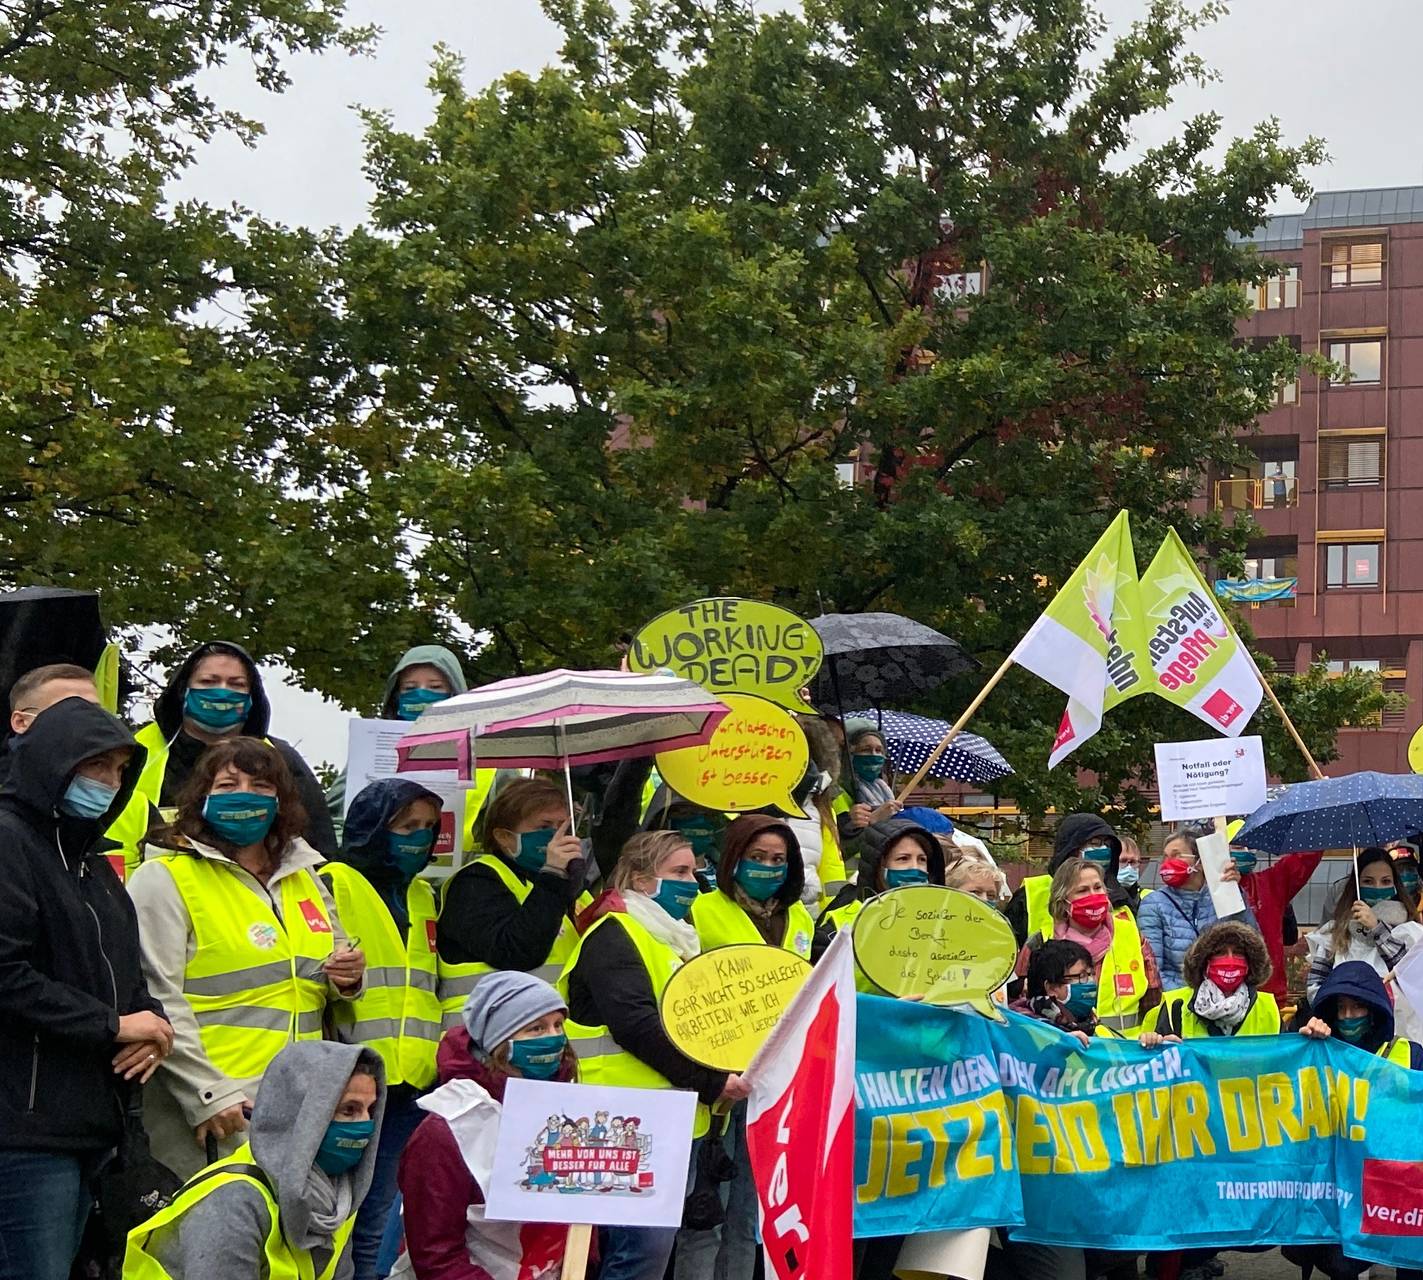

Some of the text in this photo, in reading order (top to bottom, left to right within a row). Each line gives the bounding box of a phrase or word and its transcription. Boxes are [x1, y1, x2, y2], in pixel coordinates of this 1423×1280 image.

[679, 601, 738, 628] THE
[633, 623, 805, 668] WORKING
[723, 768, 778, 786] besser
[1182, 759, 1232, 770] Notfall oder
[1186, 768, 1229, 779] Nötigung?
[879, 898, 906, 930] Je
[964, 909, 985, 924] der
[889, 945, 978, 961] desto asozialer
[714, 956, 753, 985] KANN
[672, 995, 700, 1017] GAR
[702, 984, 735, 1007] NICHT
[756, 960, 804, 990] SCHLECHT
[740, 999, 759, 1018] WIE
[763, 992, 779, 1010] ICH
[860, 1064, 948, 1108] HALTEN
[950, 1053, 999, 1096] DEN
[1040, 1064, 1084, 1098] AM
[548, 1149, 637, 1160] MEHR VON UNS IST
[856, 1090, 1014, 1204] JETZT
[1112, 1081, 1217, 1168] IHR
[552, 1161, 585, 1171] BESSER
[609, 1162, 630, 1171] ALLE
